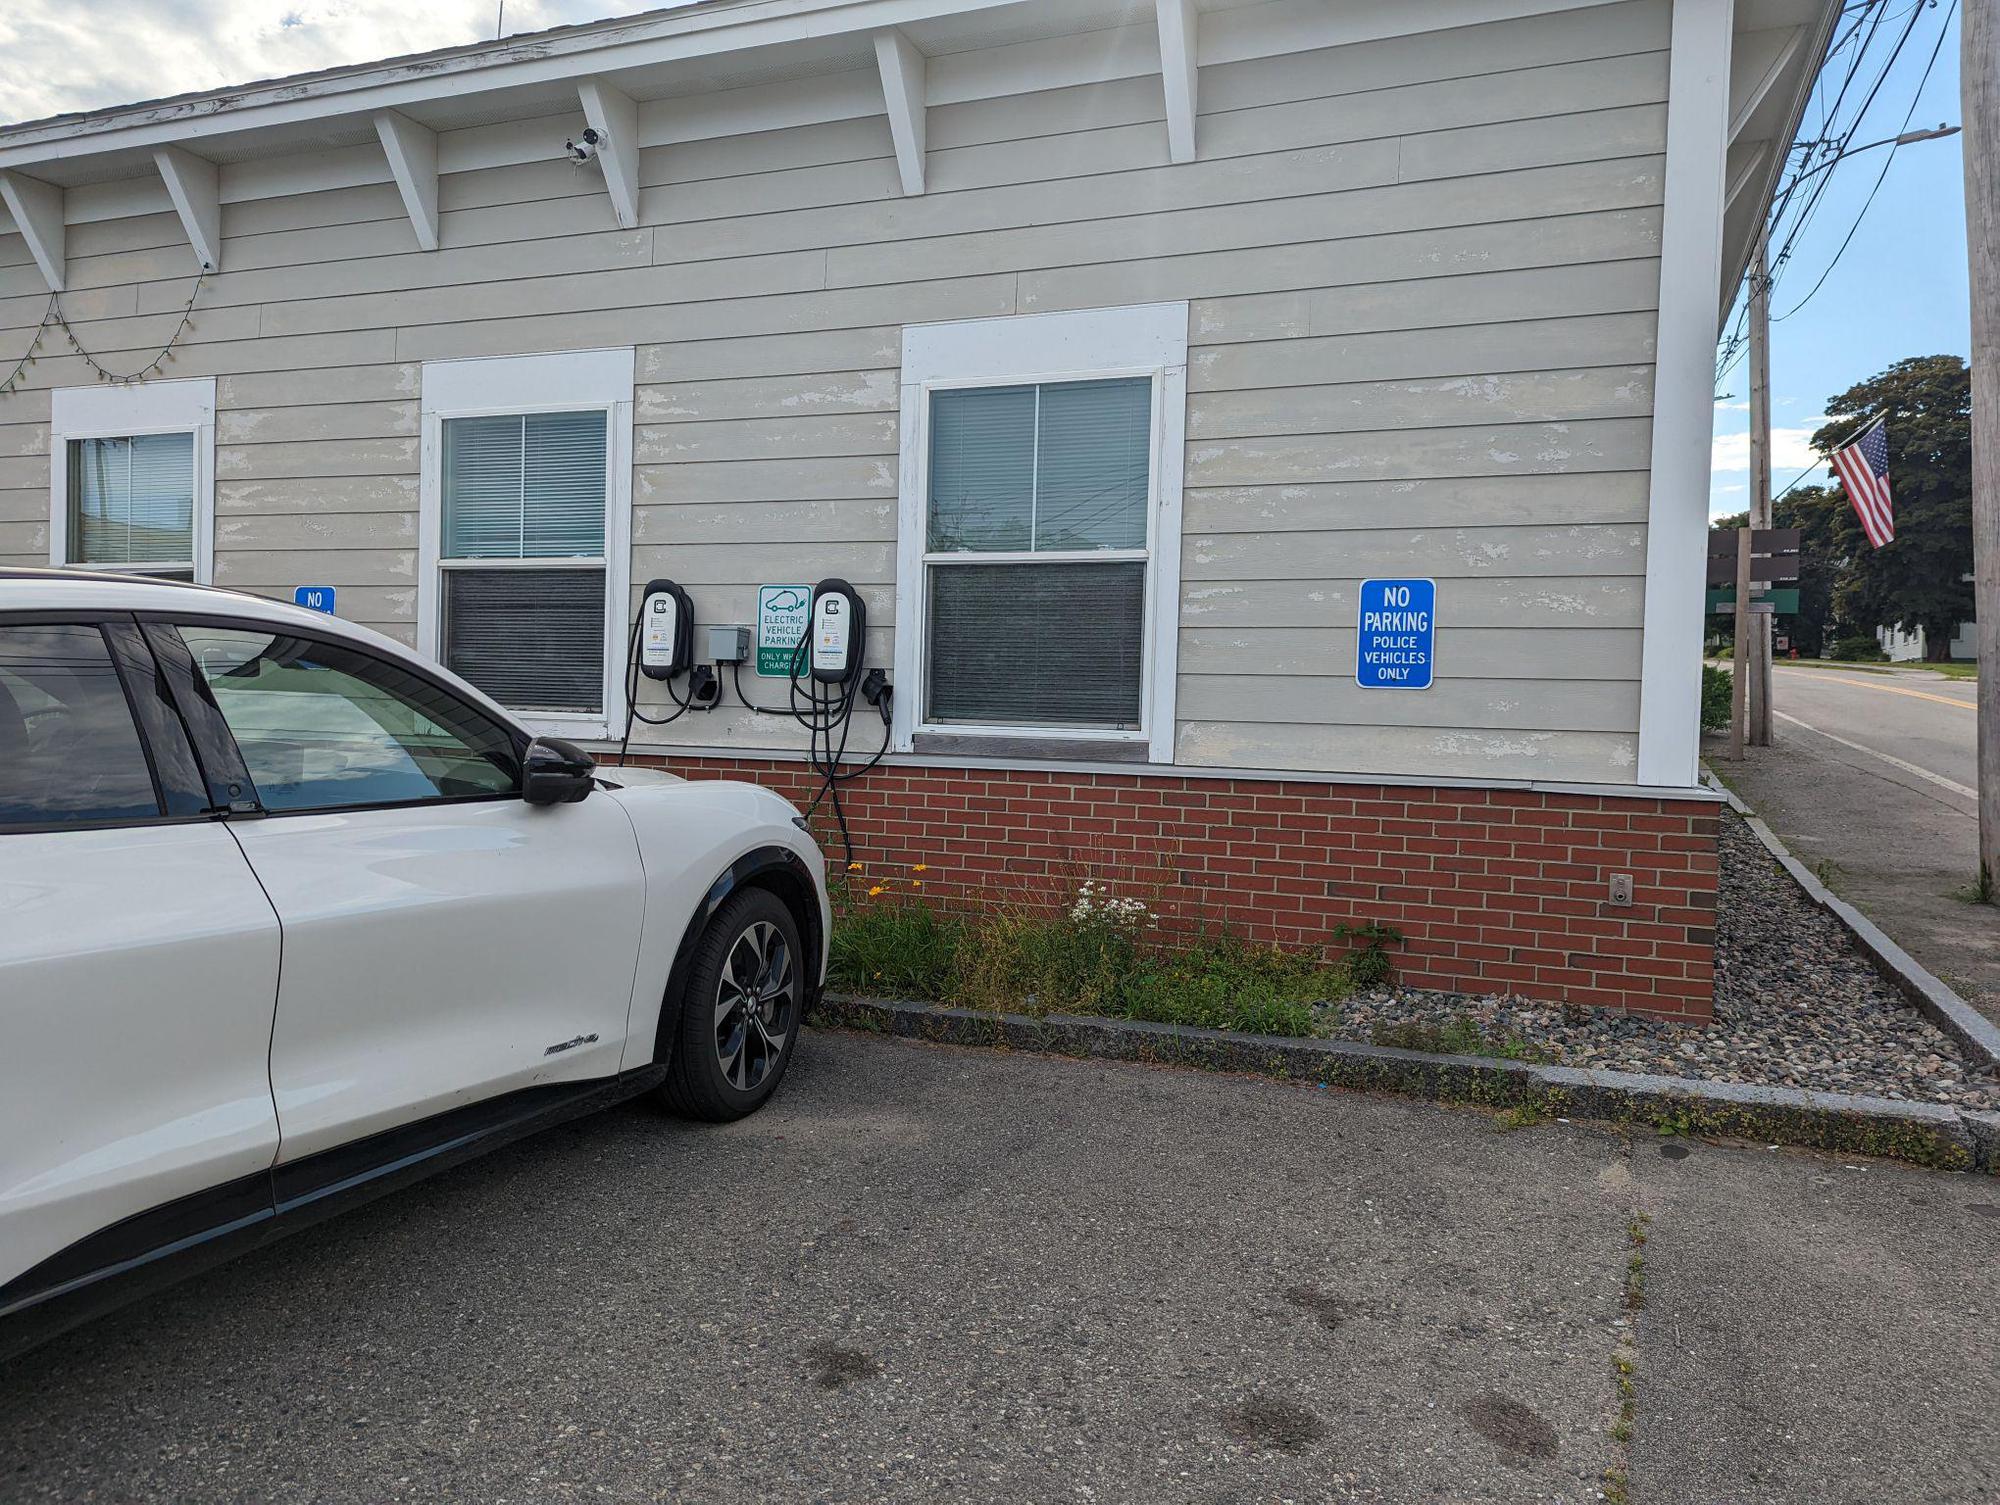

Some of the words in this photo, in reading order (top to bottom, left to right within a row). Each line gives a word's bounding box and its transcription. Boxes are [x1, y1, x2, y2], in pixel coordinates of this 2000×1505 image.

[307, 592, 322, 607] NO
[1383, 586, 1410, 608] NO
[764, 615, 804, 624] ELECTRIC
[1364, 611, 1428, 632] PARKING
[766, 625, 802, 634] VEHICLE
[1372, 636, 1418, 648] POLICE
[761, 652, 781, 661] ONLY
[1364, 652, 1426, 664] VEHICLES
[1377, 667, 1410, 680] ONLY
